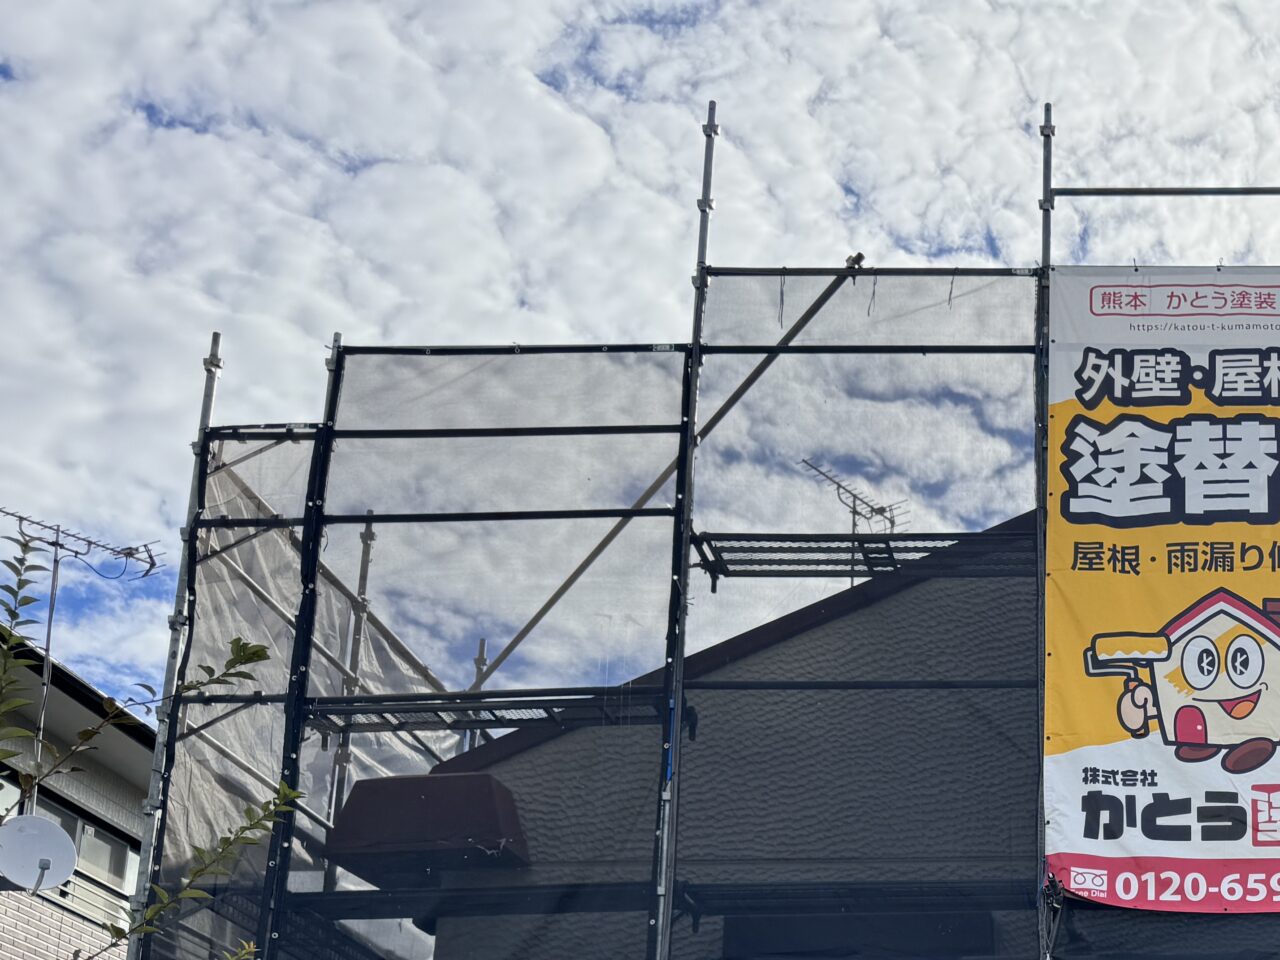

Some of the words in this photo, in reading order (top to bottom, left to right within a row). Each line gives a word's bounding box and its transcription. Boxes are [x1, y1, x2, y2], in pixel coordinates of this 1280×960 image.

[1100, 291, 1147, 311] 熊本
[1166, 291, 1277, 310] かとう塗装
[1082, 767, 1158, 787] 株式会社
[1090, 890, 1107, 898] Dial
